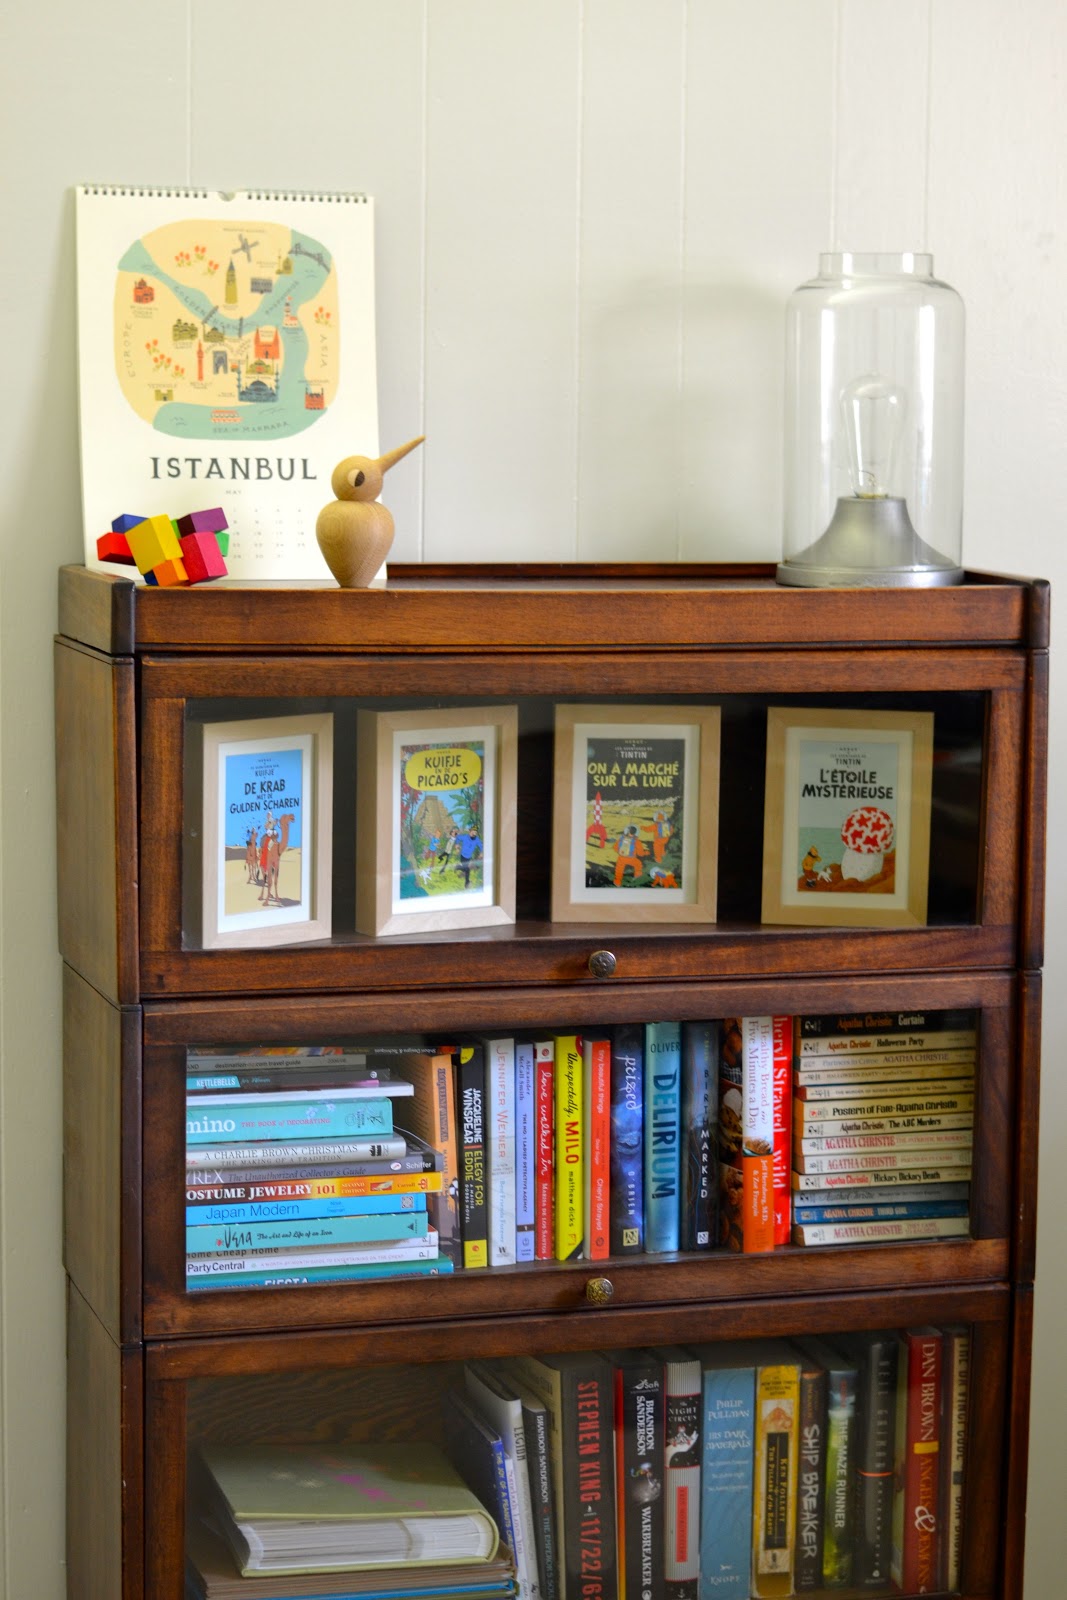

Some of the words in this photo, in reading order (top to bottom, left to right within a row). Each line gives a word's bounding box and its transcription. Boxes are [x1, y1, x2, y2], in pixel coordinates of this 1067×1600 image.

[120, 321, 136, 378] EUROPE
[320, 333, 329, 368] ASIA
[149, 457, 318, 481] ISTANBUL
[425, 755, 463, 769] KUIFJE
[620, 751, 648, 760] TINTIN
[835, 758, 861, 766] TINTIN
[255, 768, 275, 778] KUIFJE
[587, 762, 607, 775] ON
[611, 761, 621, 775] A
[625, 761, 679, 776] MARCHÉ
[820, 768, 877, 784] L'ÉTOILE
[244, 783, 257, 796] DE
[260, 779, 286, 794] KRAB
[418, 772, 469, 788] PICARO'S
[593, 775, 617, 787] SUR
[622, 775, 640, 787] LA
[642, 775, 675, 788] LUNE
[802, 784, 893, 800] MYSTÉRIEUSE
[230, 802, 261, 814] GULDEN
[264, 797, 300, 811] SCHAREN
[898, 1014, 925, 1026] Curtain
[748, 1020, 759, 1044] Five
[849, 1039, 872, 1049] Christie
[909, 1036, 925, 1047] Party
[597, 1050, 605, 1062] tiny
[650, 1041, 681, 1053] OLIVER
[759, 1024, 770, 1071] Healthy
[748, 1046, 759, 1094] Minutes
[822, 1060, 851, 1068] Partners
[859, 1058, 879, 1066] Crime
[883, 1055, 914, 1064] AGATHA
[914, 1053, 950, 1062] CHRISTIE
[196, 1077, 236, 1088] KETTLEBELLS
[496, 1046, 509, 1106] JENNIFER
[540, 1070, 553, 1102] love
[563, 1052, 579, 1119] Unexpectedly,
[615, 1055, 643, 1110] prized
[760, 1072, 770, 1107] Bread
[773, 1067, 788, 1133] Strayed
[596, 1093, 605, 1114] things
[832, 1105, 865, 1116] Postern
[866, 1106, 874, 1114] of
[925, 1100, 958, 1109] Christie
[187, 1116, 236, 1134] mino
[287, 1118, 331, 1126] DECORATING
[463, 1088, 474, 1144] WINSPEAR
[473, 1088, 483, 1143] JACQUELINE
[746, 1107, 759, 1131] Day
[761, 1110, 767, 1124] in
[841, 1123, 861, 1134] Agatha
[862, 1122, 885, 1131] Christie
[889, 1120, 901, 1128] The
[902, 1119, 916, 1127] ABC
[917, 1118, 941, 1127] Murders
[497, 1109, 509, 1158] WEINER
[540, 1104, 551, 1156] walked
[651, 1068, 678, 1199] DELIRIUM
[204, 1151, 212, 1162] A
[214, 1148, 259, 1161] CHARLIE
[262, 1145, 300, 1158] BROWN
[301, 1142, 359, 1156] CHRISTMAS
[565, 1121, 580, 1164] MILO
[825, 1137, 857, 1150] AGATHA
[858, 1135, 896, 1148] CHRISTIE
[240, 1158, 271, 1166] MAKING
[298, 1153, 342, 1163] TRADITION
[406, 1162, 433, 1172] Schiffer
[464, 1150, 474, 1182] EDDIE
[473, 1150, 484, 1182] ELEGY
[540, 1157, 552, 1176] in
[760, 1159, 768, 1171] Jeff
[773, 1149, 787, 1189] wild
[827, 1159, 860, 1171] AGATHA
[860, 1156, 897, 1168] CHRISTIE
[229, 1173, 242, 1182] The
[243, 1169, 297, 1182] Unauthorized
[299, 1165, 342, 1178] Collector's
[343, 1166, 368, 1175] Guide
[825, 1176, 847, 1188] Agatha
[847, 1174, 869, 1185] Christie
[923, 1171, 941, 1180] Death
[187, 1187, 246, 1201] OSTUME
[247, 1184, 314, 1201] JEWELRY
[316, 1184, 336, 1195] 101
[474, 1184, 484, 1206] FOR
[568, 1171, 576, 1204] matthew
[596, 1178, 604, 1201] Cheryl
[627, 1171, 635, 1216] O'BRIEN
[206, 1207, 246, 1222] Japan
[249, 1203, 300, 1218] Modern
[568, 1206, 576, 1227] dicks
[596, 1203, 604, 1231] Strayed
[823, 1209, 848, 1219] AGATHA
[848, 1208, 874, 1217] CHRISTIE
[224, 1226, 254, 1248] Vera
[834, 1227, 866, 1239] AGATHA
[865, 1224, 903, 1237] CHRISTIE
[187, 1262, 211, 1274] Party
[212, 1260, 246, 1271] Central
[921, 1343, 936, 1378] DAN
[669, 1407, 697, 1415] NIGHT
[708, 1409, 750, 1421] PULLMAN
[716, 1400, 744, 1410] PHILIP
[920, 1382, 936, 1441] BROWN
[577, 1380, 601, 1455] STEPHEN
[636, 1396, 646, 1456] SANDERSON
[645, 1400, 655, 1450] BRANDON
[536, 1415, 546, 1454] BRANDON
[709, 1431, 722, 1440] HIS
[723, 1429, 750, 1440] DARK
[838, 1419, 849, 1442] THE
[514, 1426, 526, 1462] LEGION
[704, 1439, 753, 1450] MATERIALS
[768, 1446, 776, 1459] THE
[802, 1424, 820, 1467] SHIP
[780, 1457, 788, 1478] KEN
[836, 1444, 848, 1475] MAZE
[500, 1480, 506, 1490] OF
[540, 1455, 549, 1503] SANDERSON
[579, 1461, 602, 1502] KING
[768, 1463, 776, 1493] PILLARS
[919, 1455, 933, 1507] ANGELS
[779, 1481, 788, 1523] FOLLETT
[834, 1479, 847, 1528] RUNNER
[502, 1499, 511, 1528] PEANUTS
[767, 1512, 775, 1536] EARTH
[800, 1472, 820, 1559] BREAKER
[914, 1505, 936, 1532] &
[543, 1517, 551, 1533] THE
[544, 1534, 553, 1577] EMPEROR'S
[641, 1506, 652, 1586] WARBREAKER
